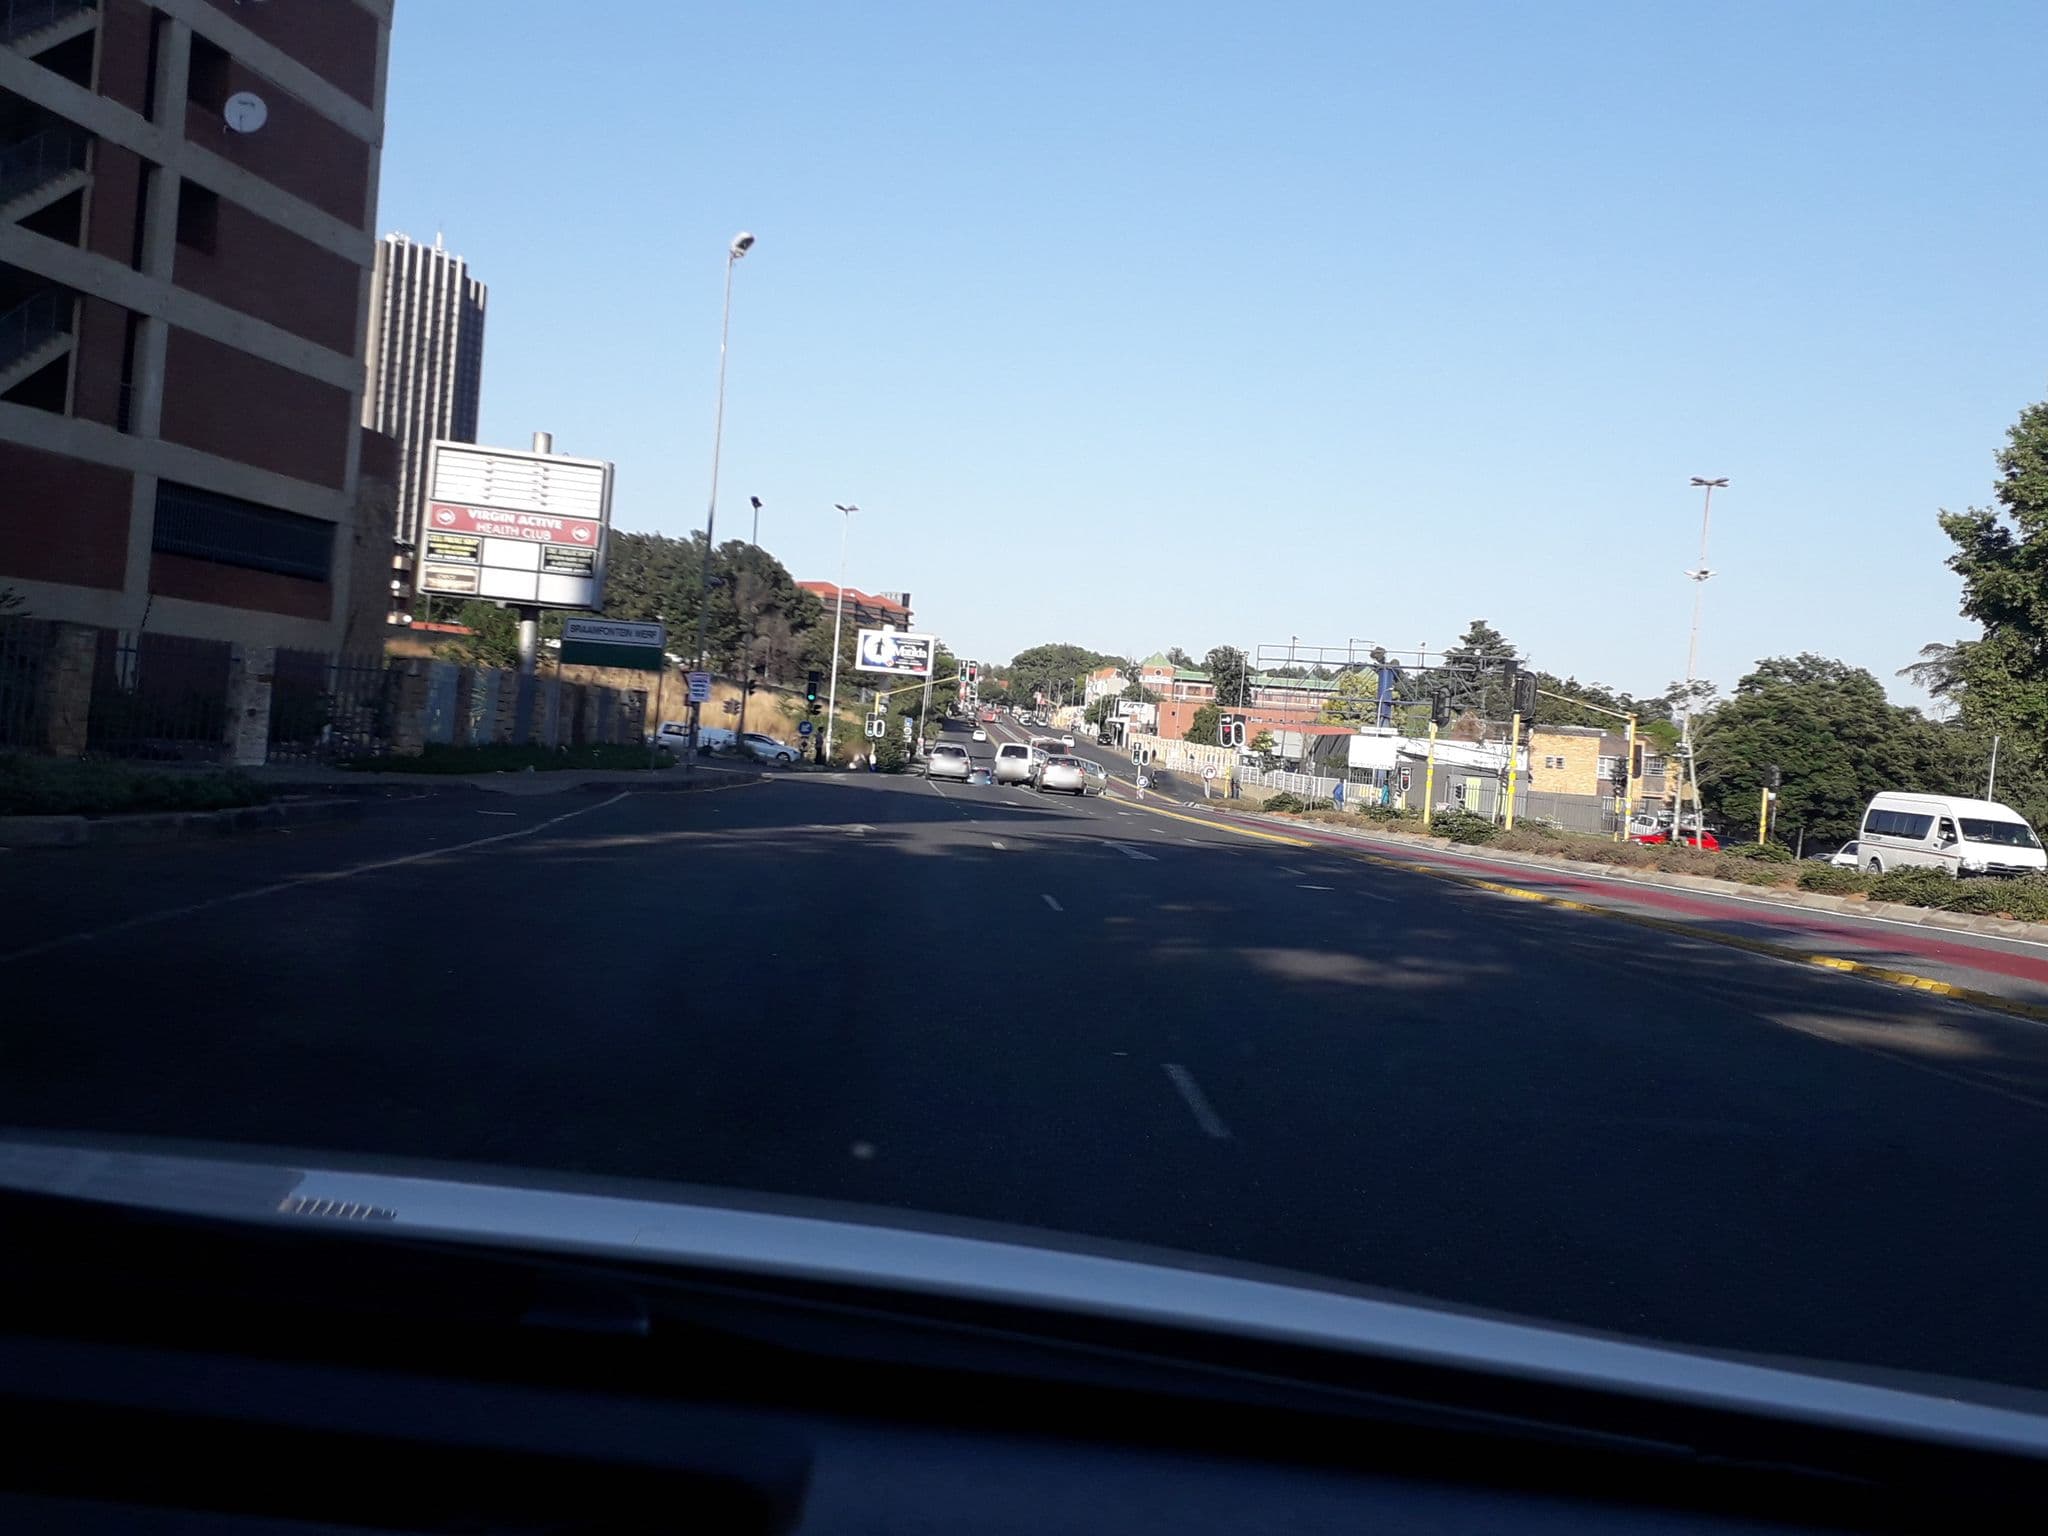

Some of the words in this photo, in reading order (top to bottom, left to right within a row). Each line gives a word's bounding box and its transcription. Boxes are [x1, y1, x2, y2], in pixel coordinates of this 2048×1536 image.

[467, 509, 515, 524] VIRGIN
[517, 516, 563, 529] ACTIVE
[476, 522, 520, 536] HEALTH
[521, 528, 552, 540] CLUB
